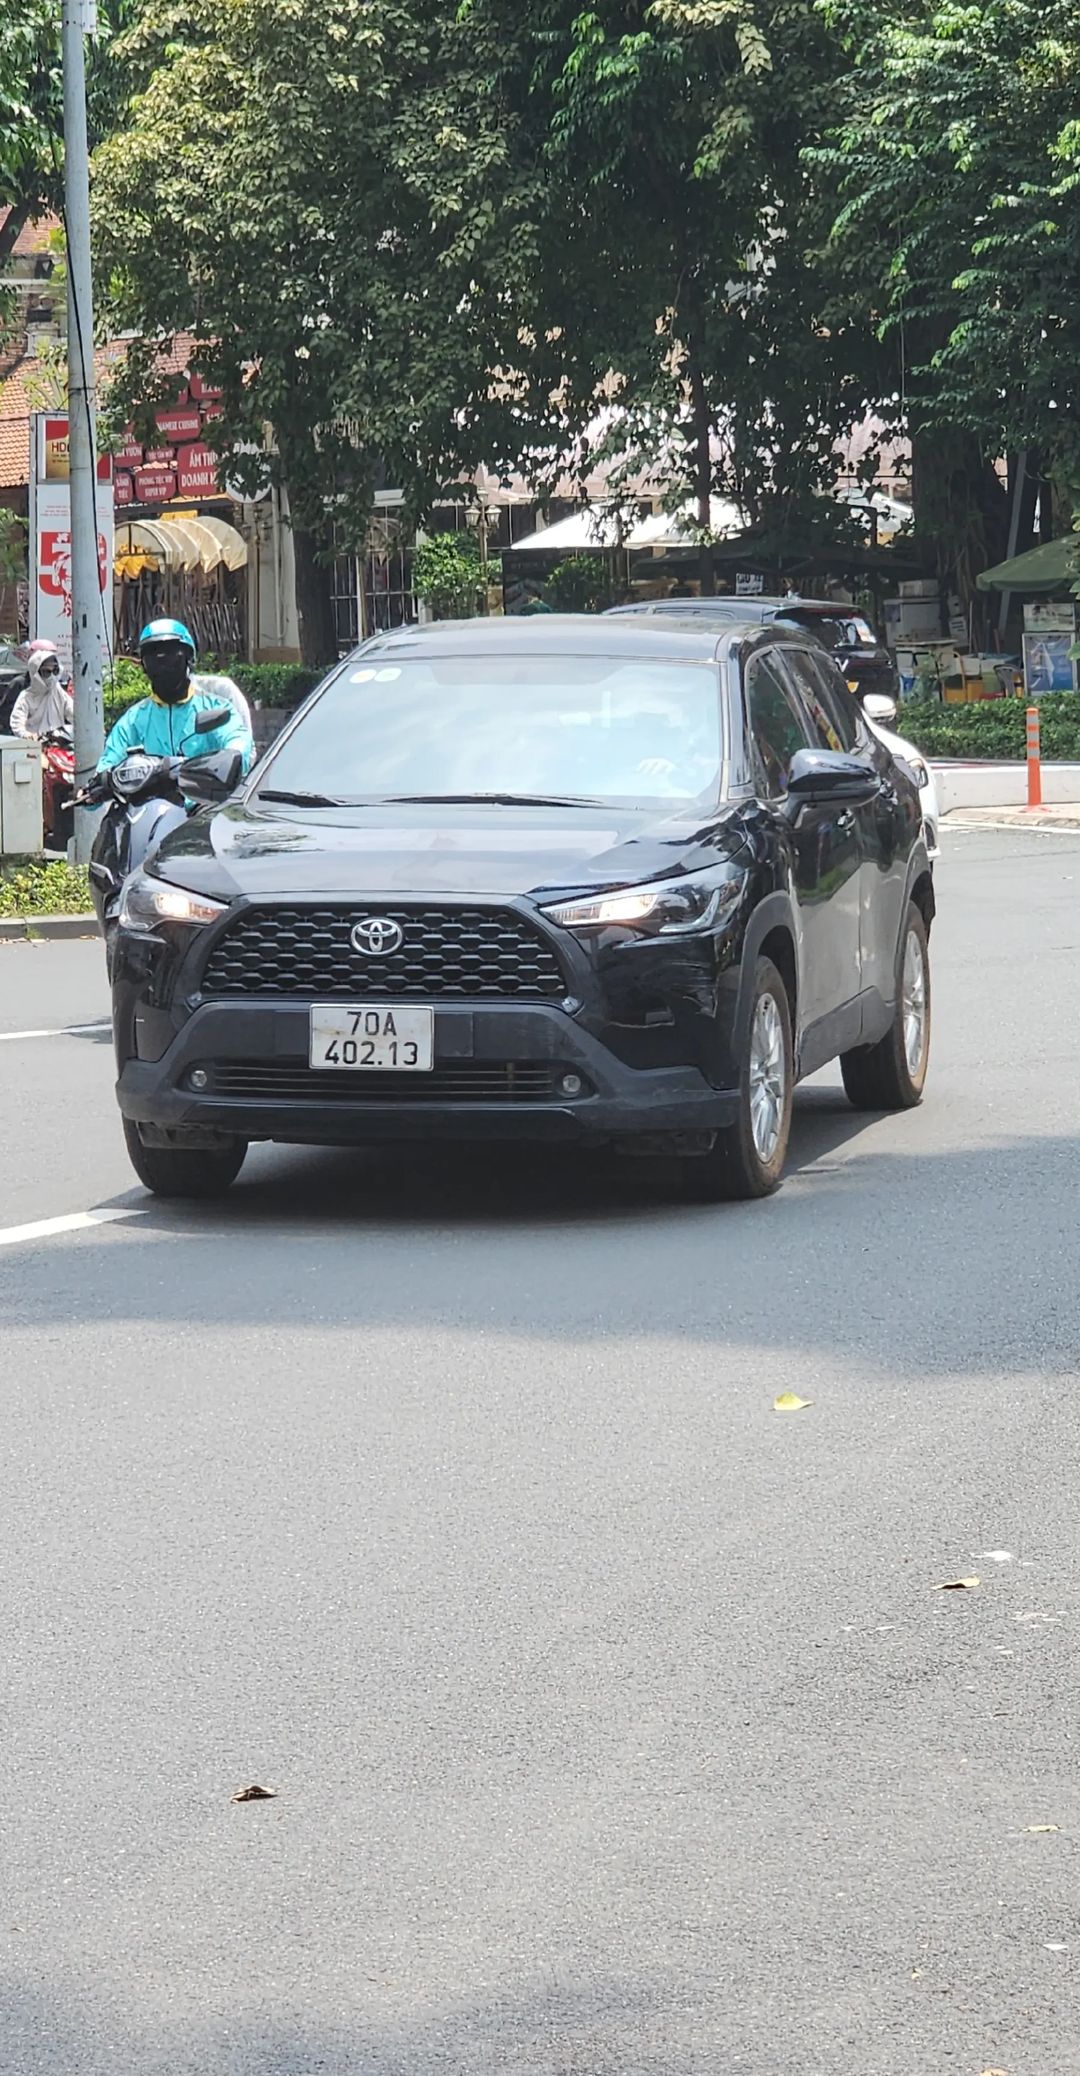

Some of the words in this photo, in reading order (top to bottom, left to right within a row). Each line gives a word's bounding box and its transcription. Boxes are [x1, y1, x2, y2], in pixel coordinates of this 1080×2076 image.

[181, 472, 208, 487] DOANH
[347, 1011, 397, 1036] 70A
[324, 1040, 418, 1066] 402.13
